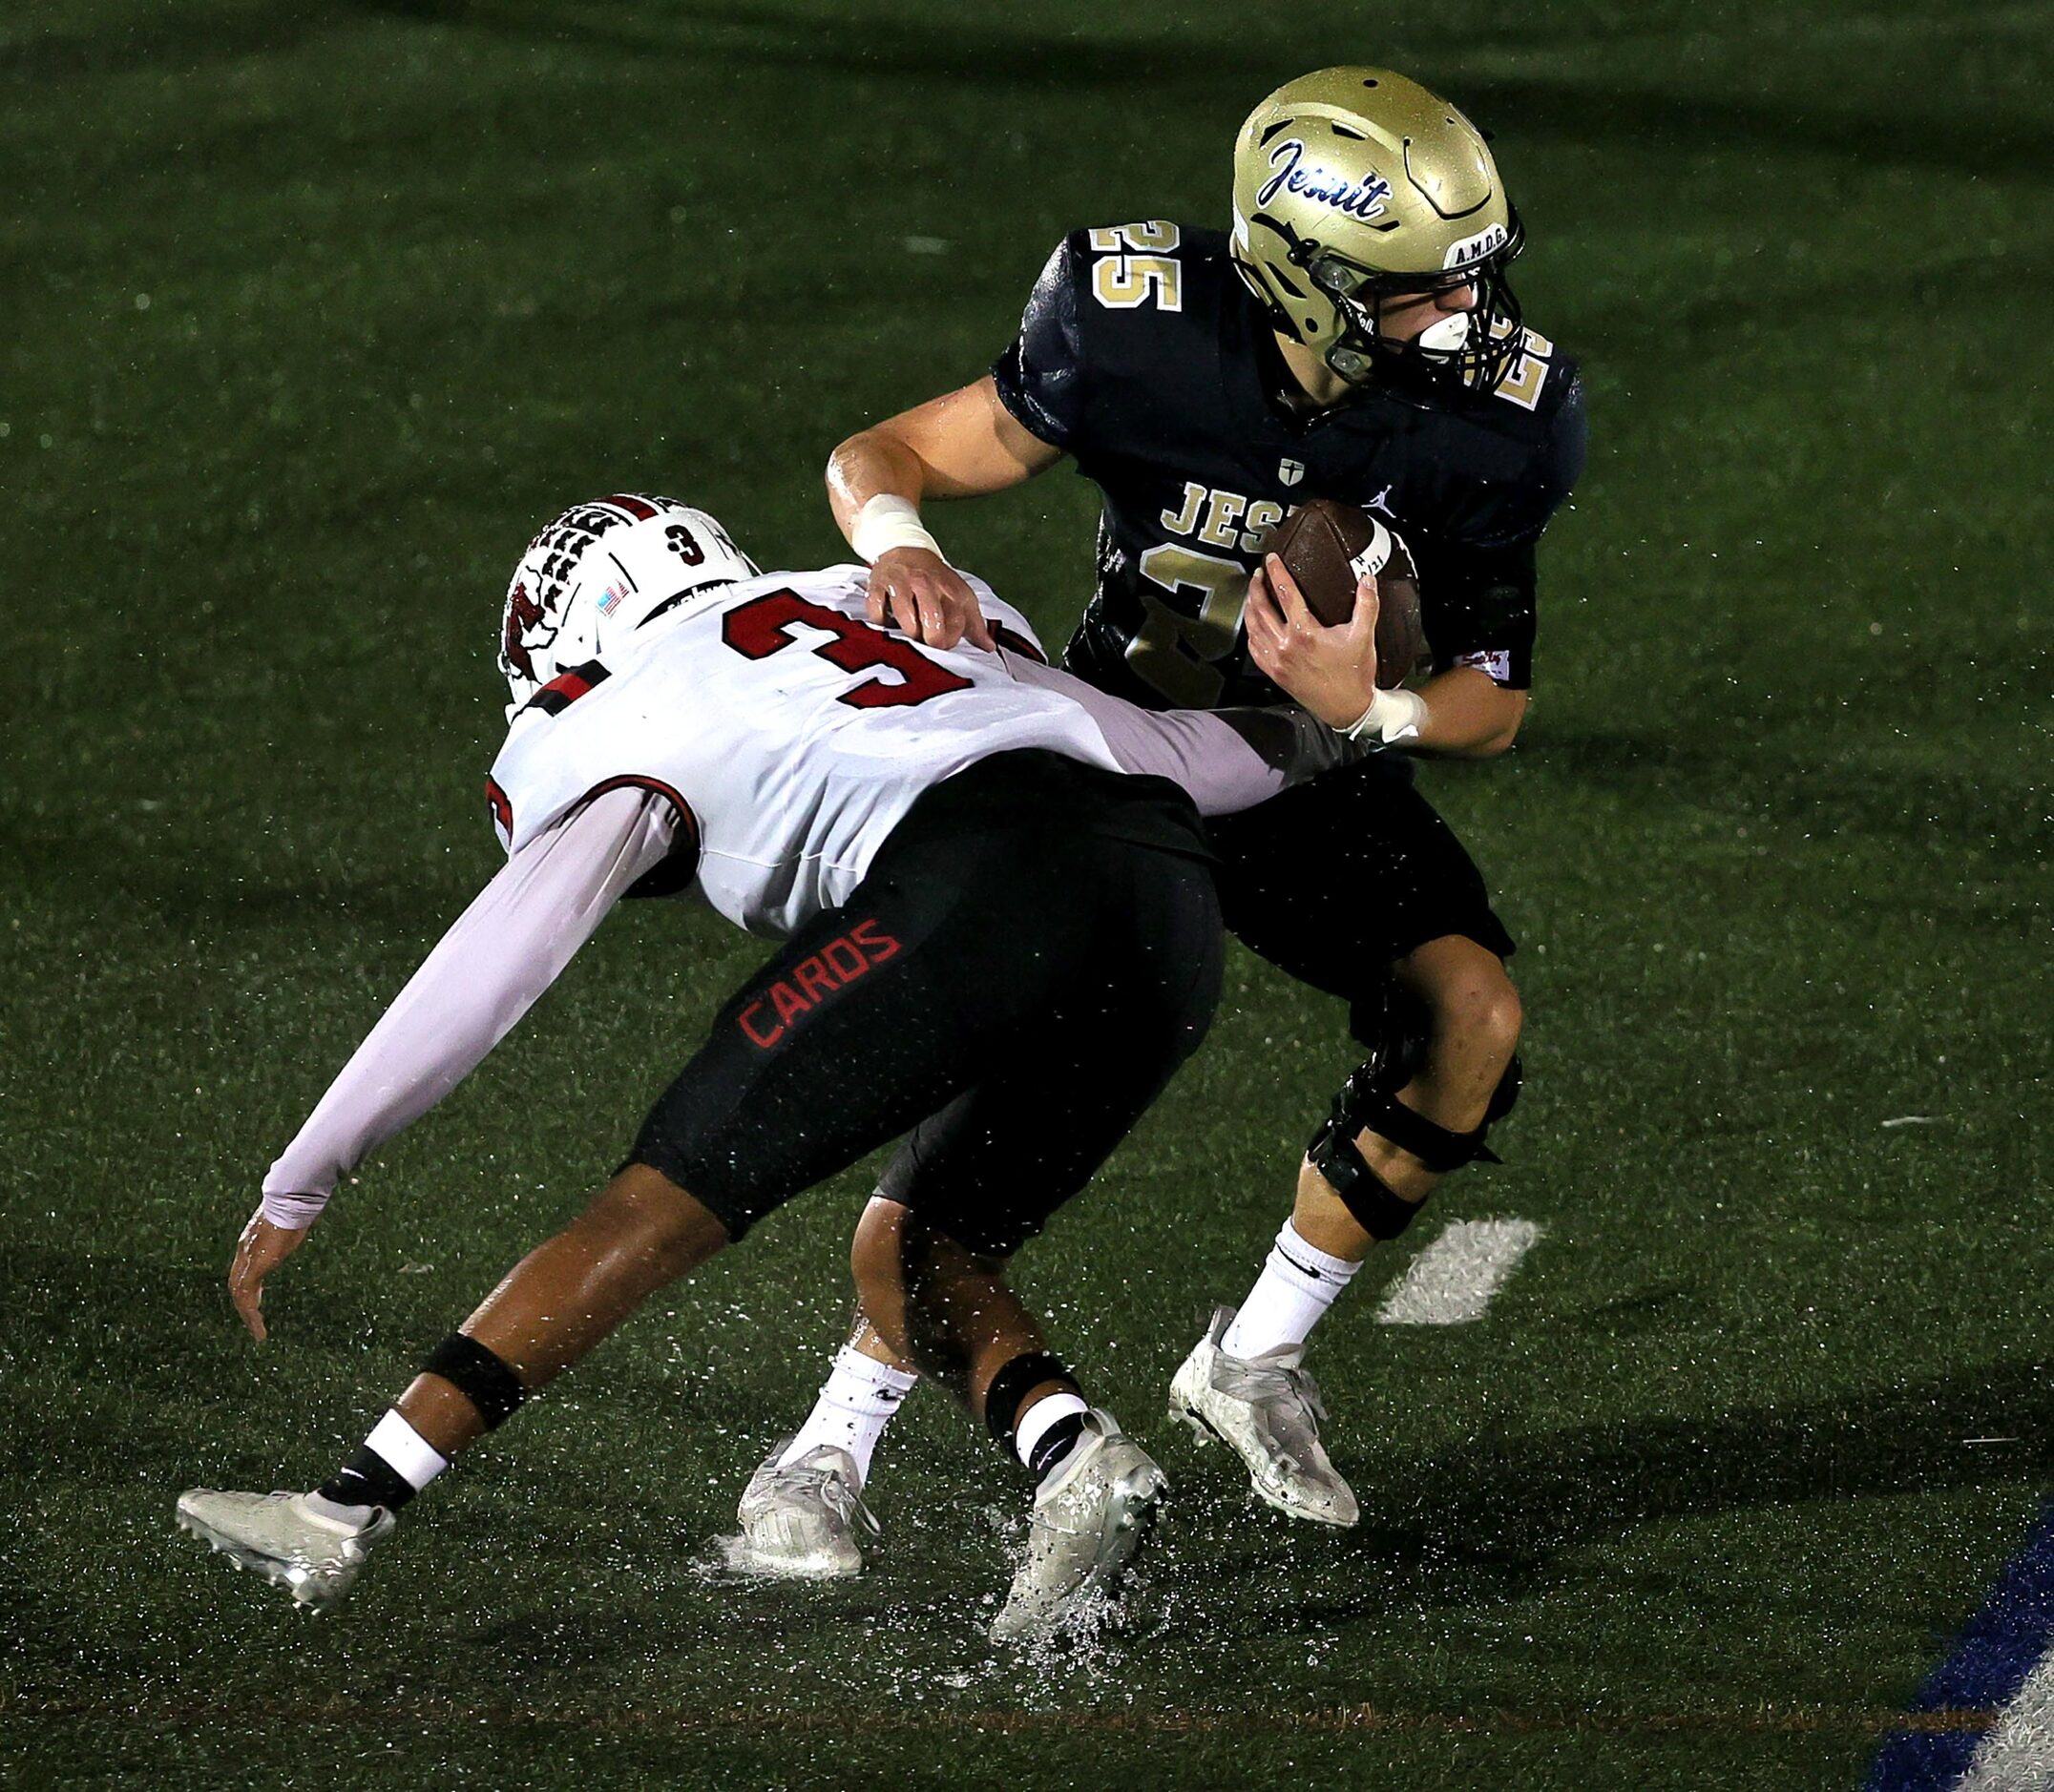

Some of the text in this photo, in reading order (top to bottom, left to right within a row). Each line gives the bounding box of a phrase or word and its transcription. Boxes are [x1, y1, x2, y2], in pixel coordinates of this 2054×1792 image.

[1257, 139, 1392, 219] Jesuit
[1088, 219, 1183, 313] 25
[1456, 227, 1506, 265] A.M.D.G.
[664, 524, 705, 567] 3
[1160, 481, 1301, 554] JES
[723, 587, 975, 709] 3
[739, 918, 902, 1049] CARDS
